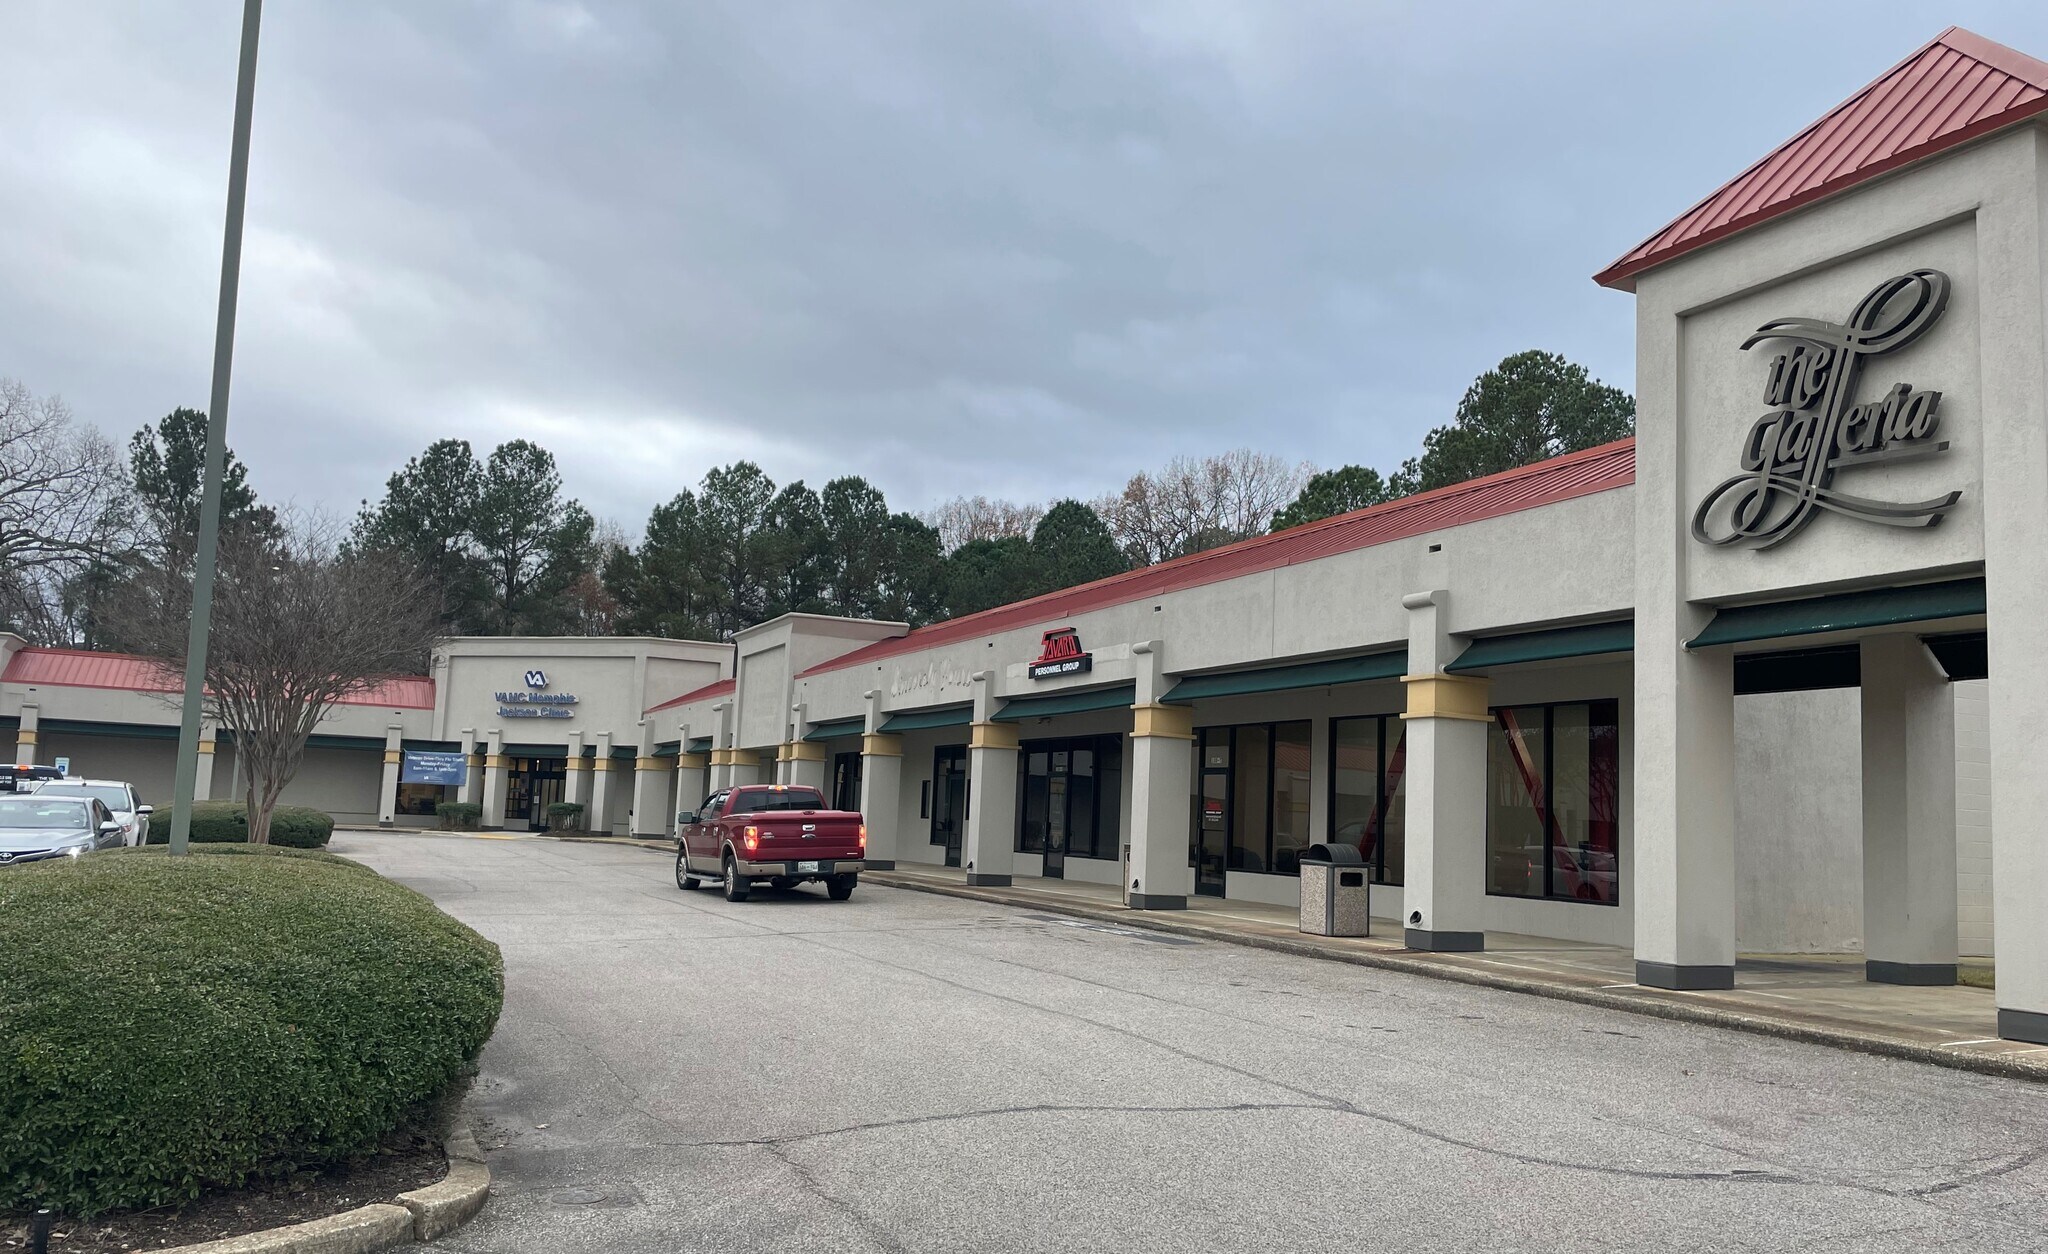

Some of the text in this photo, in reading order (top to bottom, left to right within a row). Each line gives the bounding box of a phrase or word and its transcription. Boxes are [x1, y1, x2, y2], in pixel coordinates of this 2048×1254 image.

[1763, 345, 1832, 411] the
[1035, 661, 1080, 676] PERSONNEL GROUP
[495, 692, 577, 705] VAMC Memphis
[496, 706, 573, 718] Jackson Clinic
